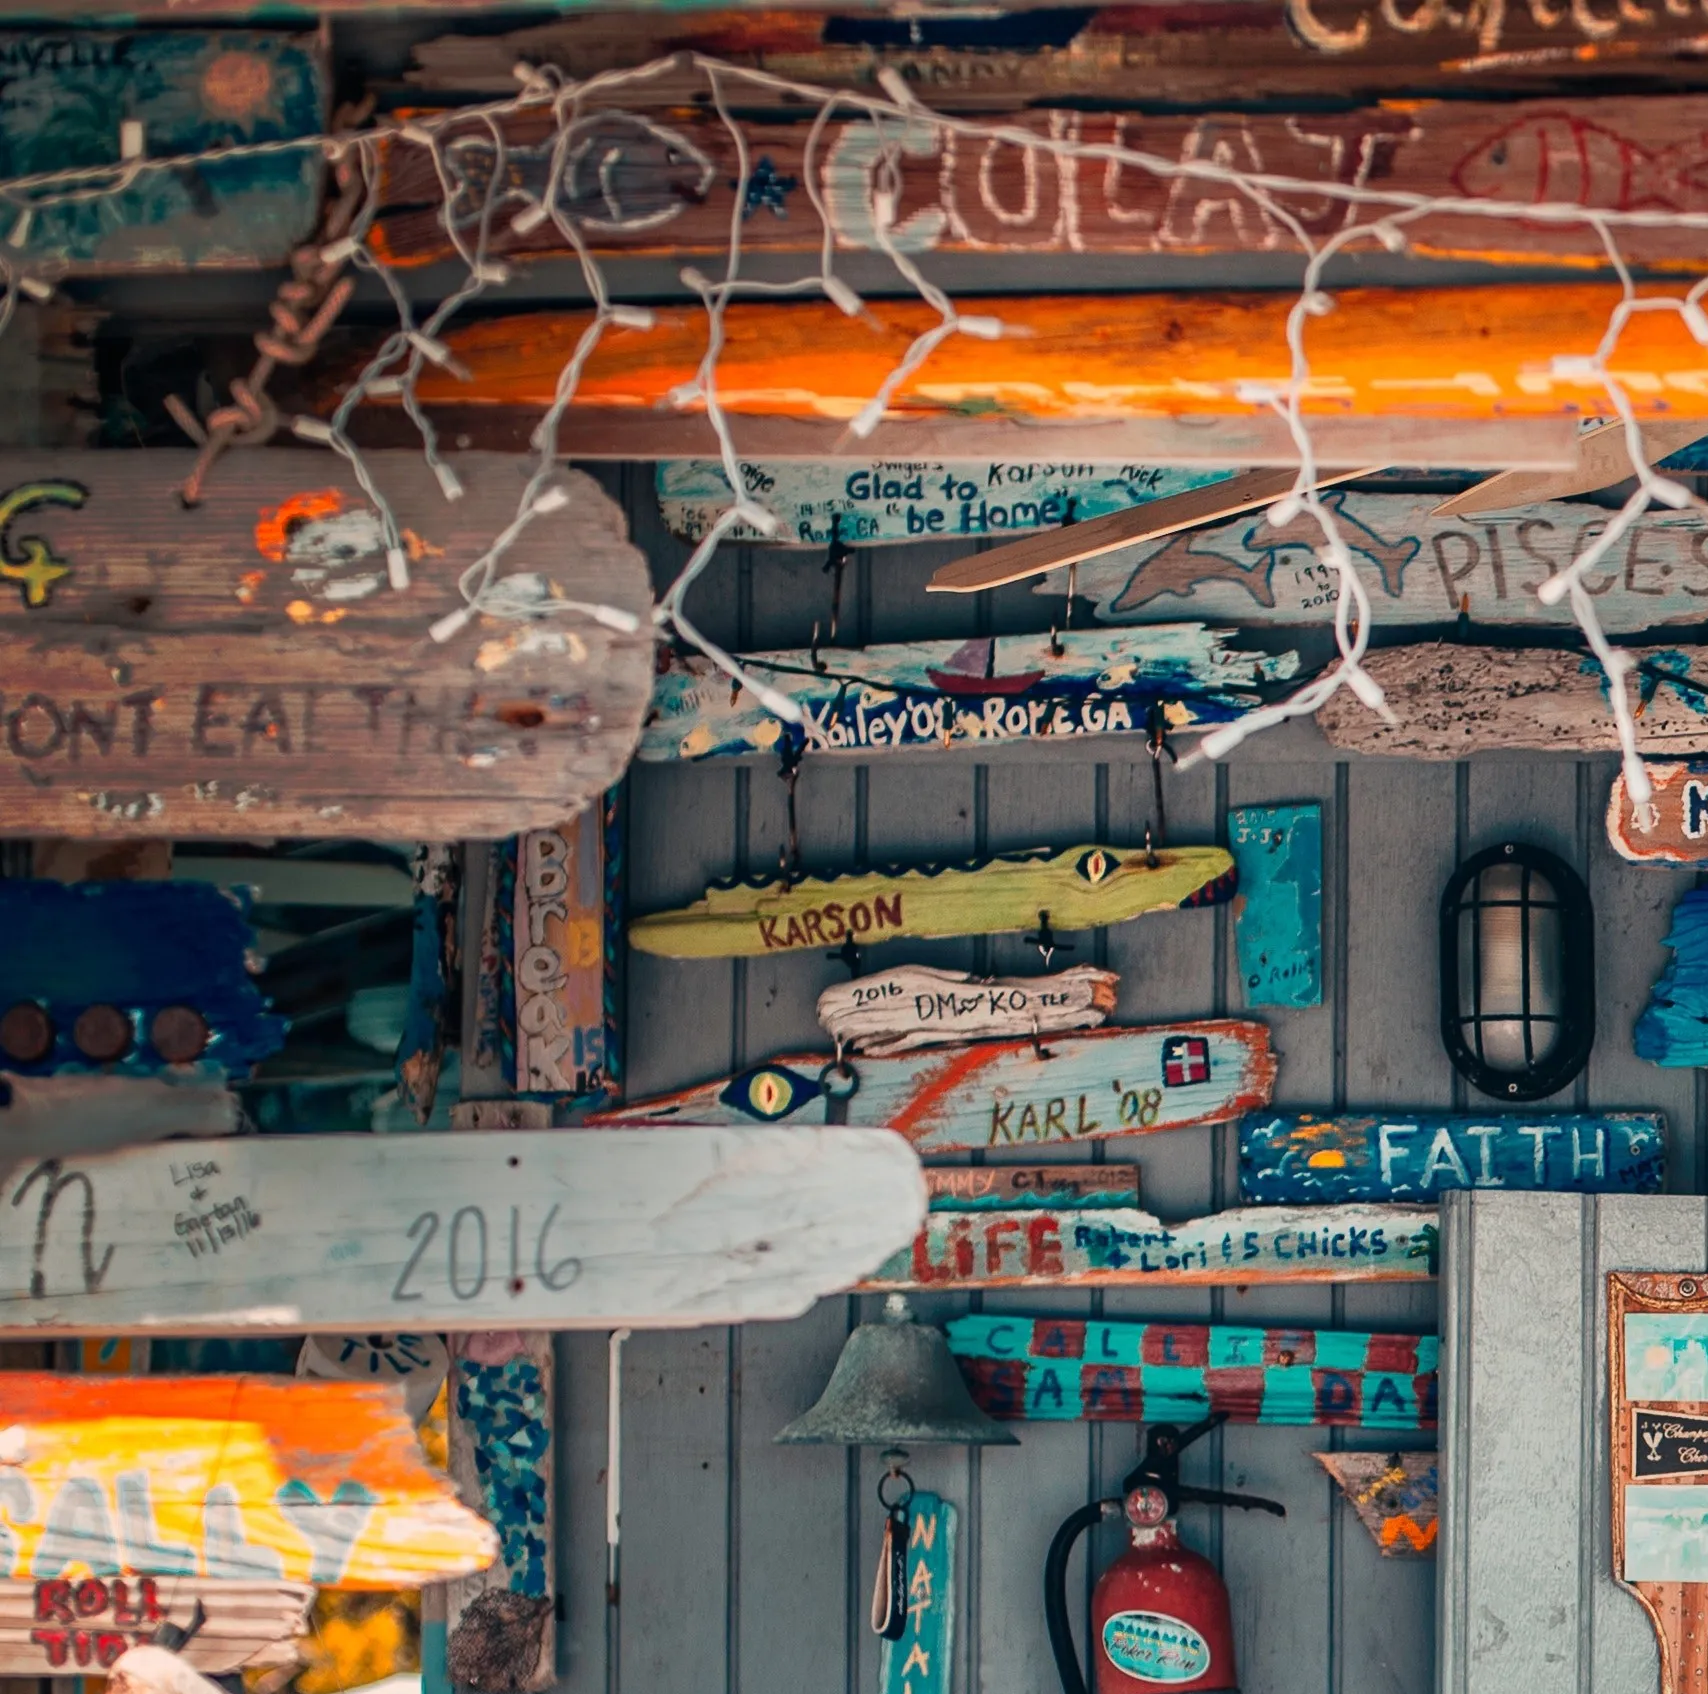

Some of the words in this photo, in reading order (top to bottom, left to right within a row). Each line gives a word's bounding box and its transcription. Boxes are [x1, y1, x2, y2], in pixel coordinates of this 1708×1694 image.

[844, 468, 926, 501] Glad
[941, 471, 979, 501] to
[906, 502, 945, 535] be
[960, 496, 1070, 534] Home
[799, 695, 907, 751] Kailey
[758, 892, 904, 950] KARSON
[851, 984, 904, 1008] 2016
[988, 1092, 1102, 1147] KARL
[1377, 1122, 1609, 1190] FAITH
[391, 1203, 583, 1303] 2016
[1242, 1230, 1262, 1259] 5
[33, 1577, 164, 1627] ROLL
